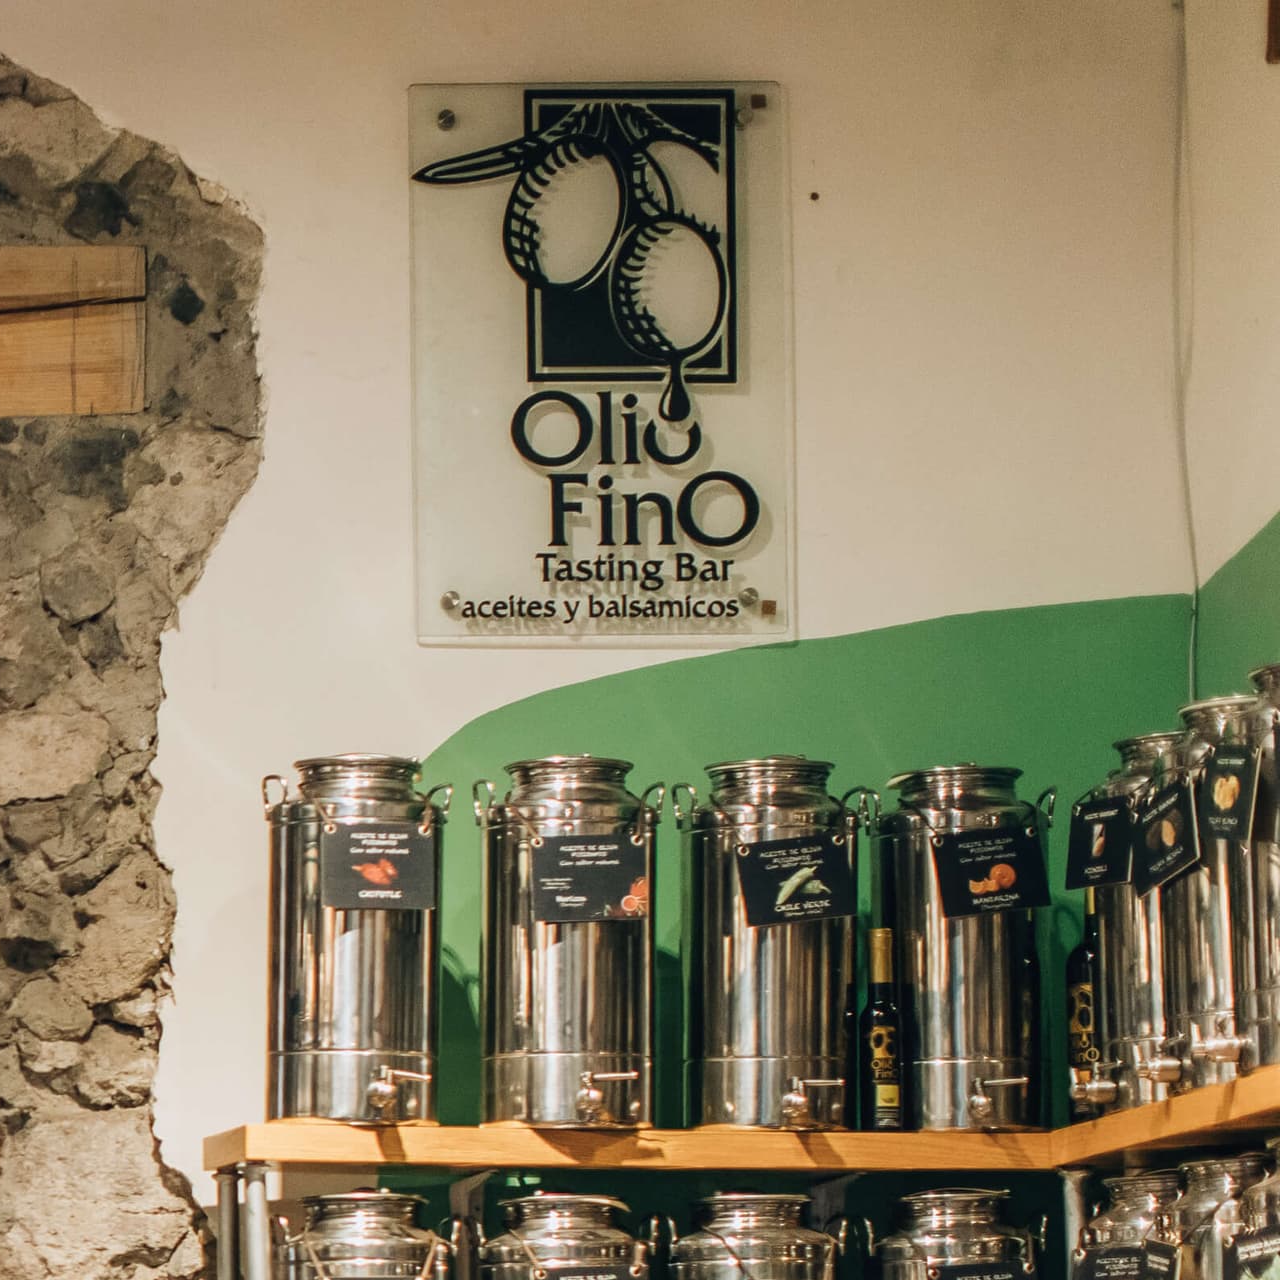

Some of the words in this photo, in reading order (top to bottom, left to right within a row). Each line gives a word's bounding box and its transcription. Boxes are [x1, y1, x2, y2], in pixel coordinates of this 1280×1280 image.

[535, 552, 664, 591] Tasting
[675, 553, 735, 582] Bar
[461, 596, 557, 618] aceites
[562, 600, 581, 624] y
[588, 595, 740, 619] balsamicos
